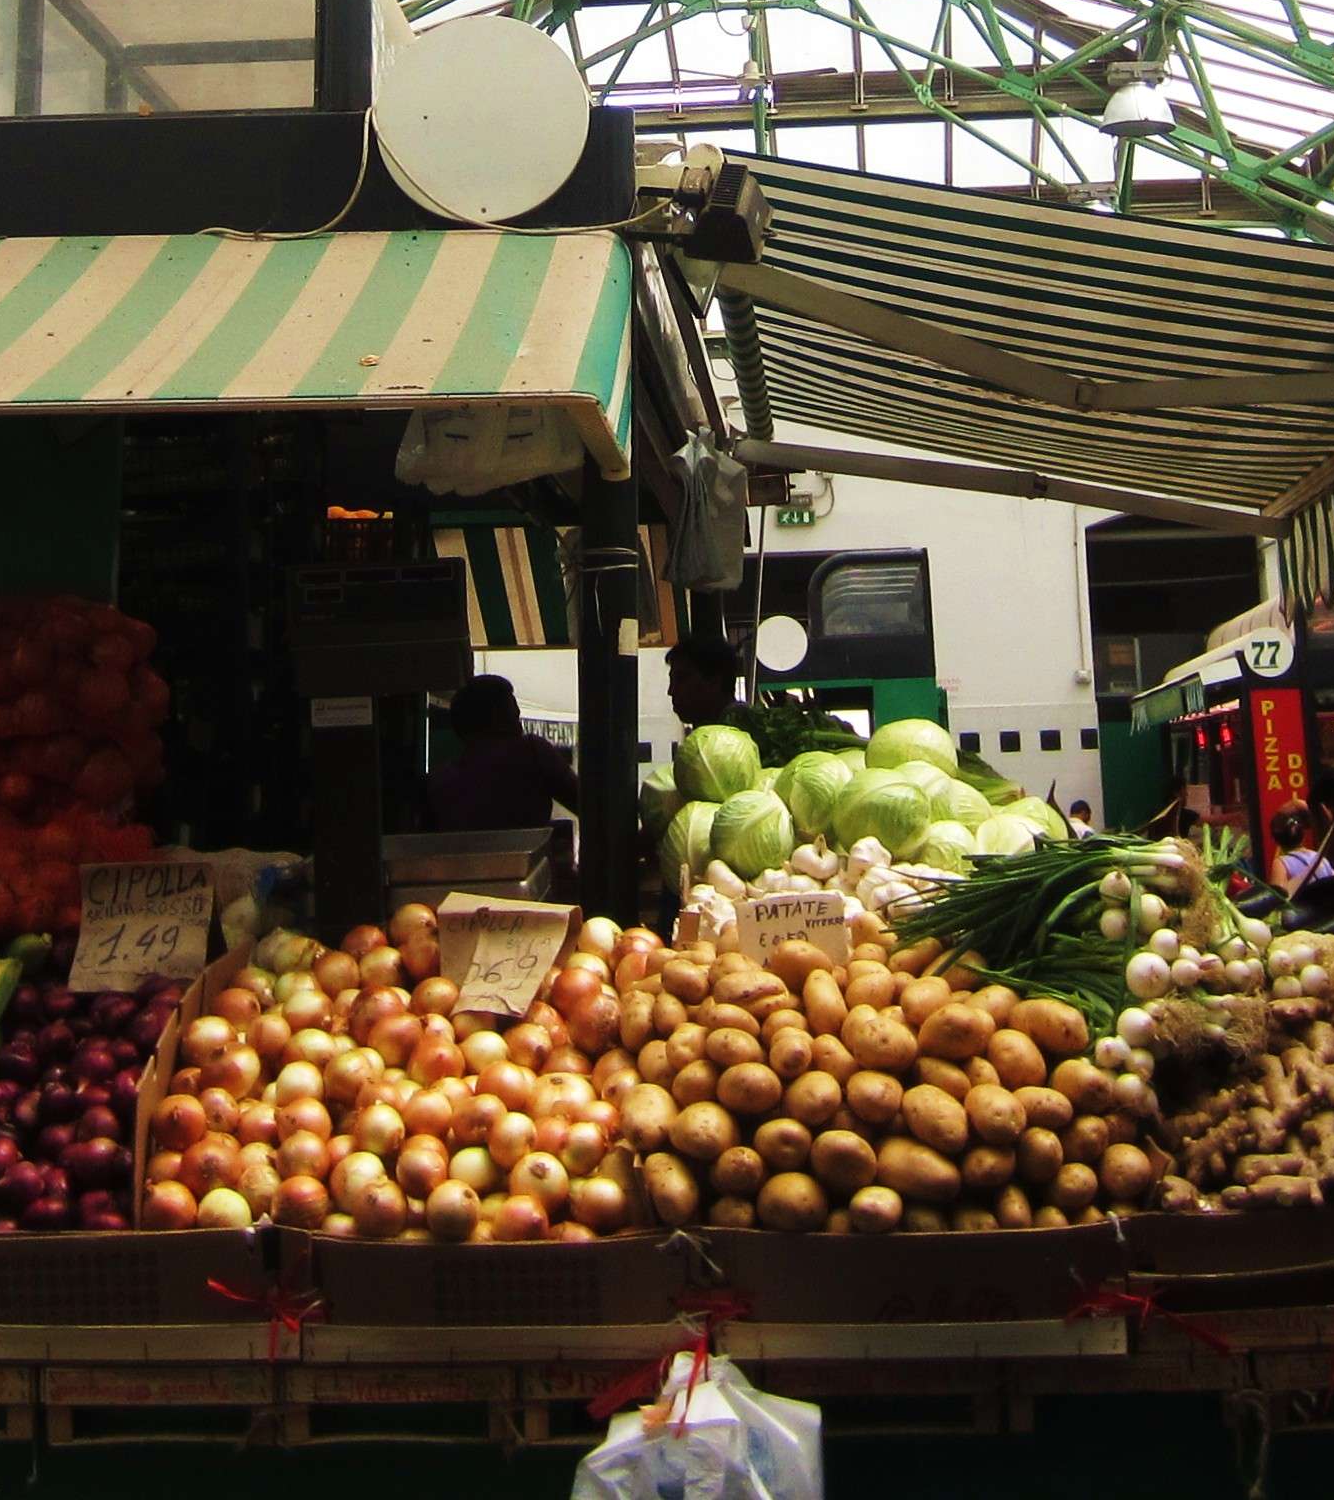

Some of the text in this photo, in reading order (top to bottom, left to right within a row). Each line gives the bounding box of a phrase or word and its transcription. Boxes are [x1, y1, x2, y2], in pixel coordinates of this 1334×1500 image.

[1251, 641, 1281, 667] 77
[1261, 700, 1284, 791] PIZZA
[88, 865, 207, 905] CIPOLLA
[755, 900, 828, 922] PATATE
[99, 923, 179, 965] 1.49
